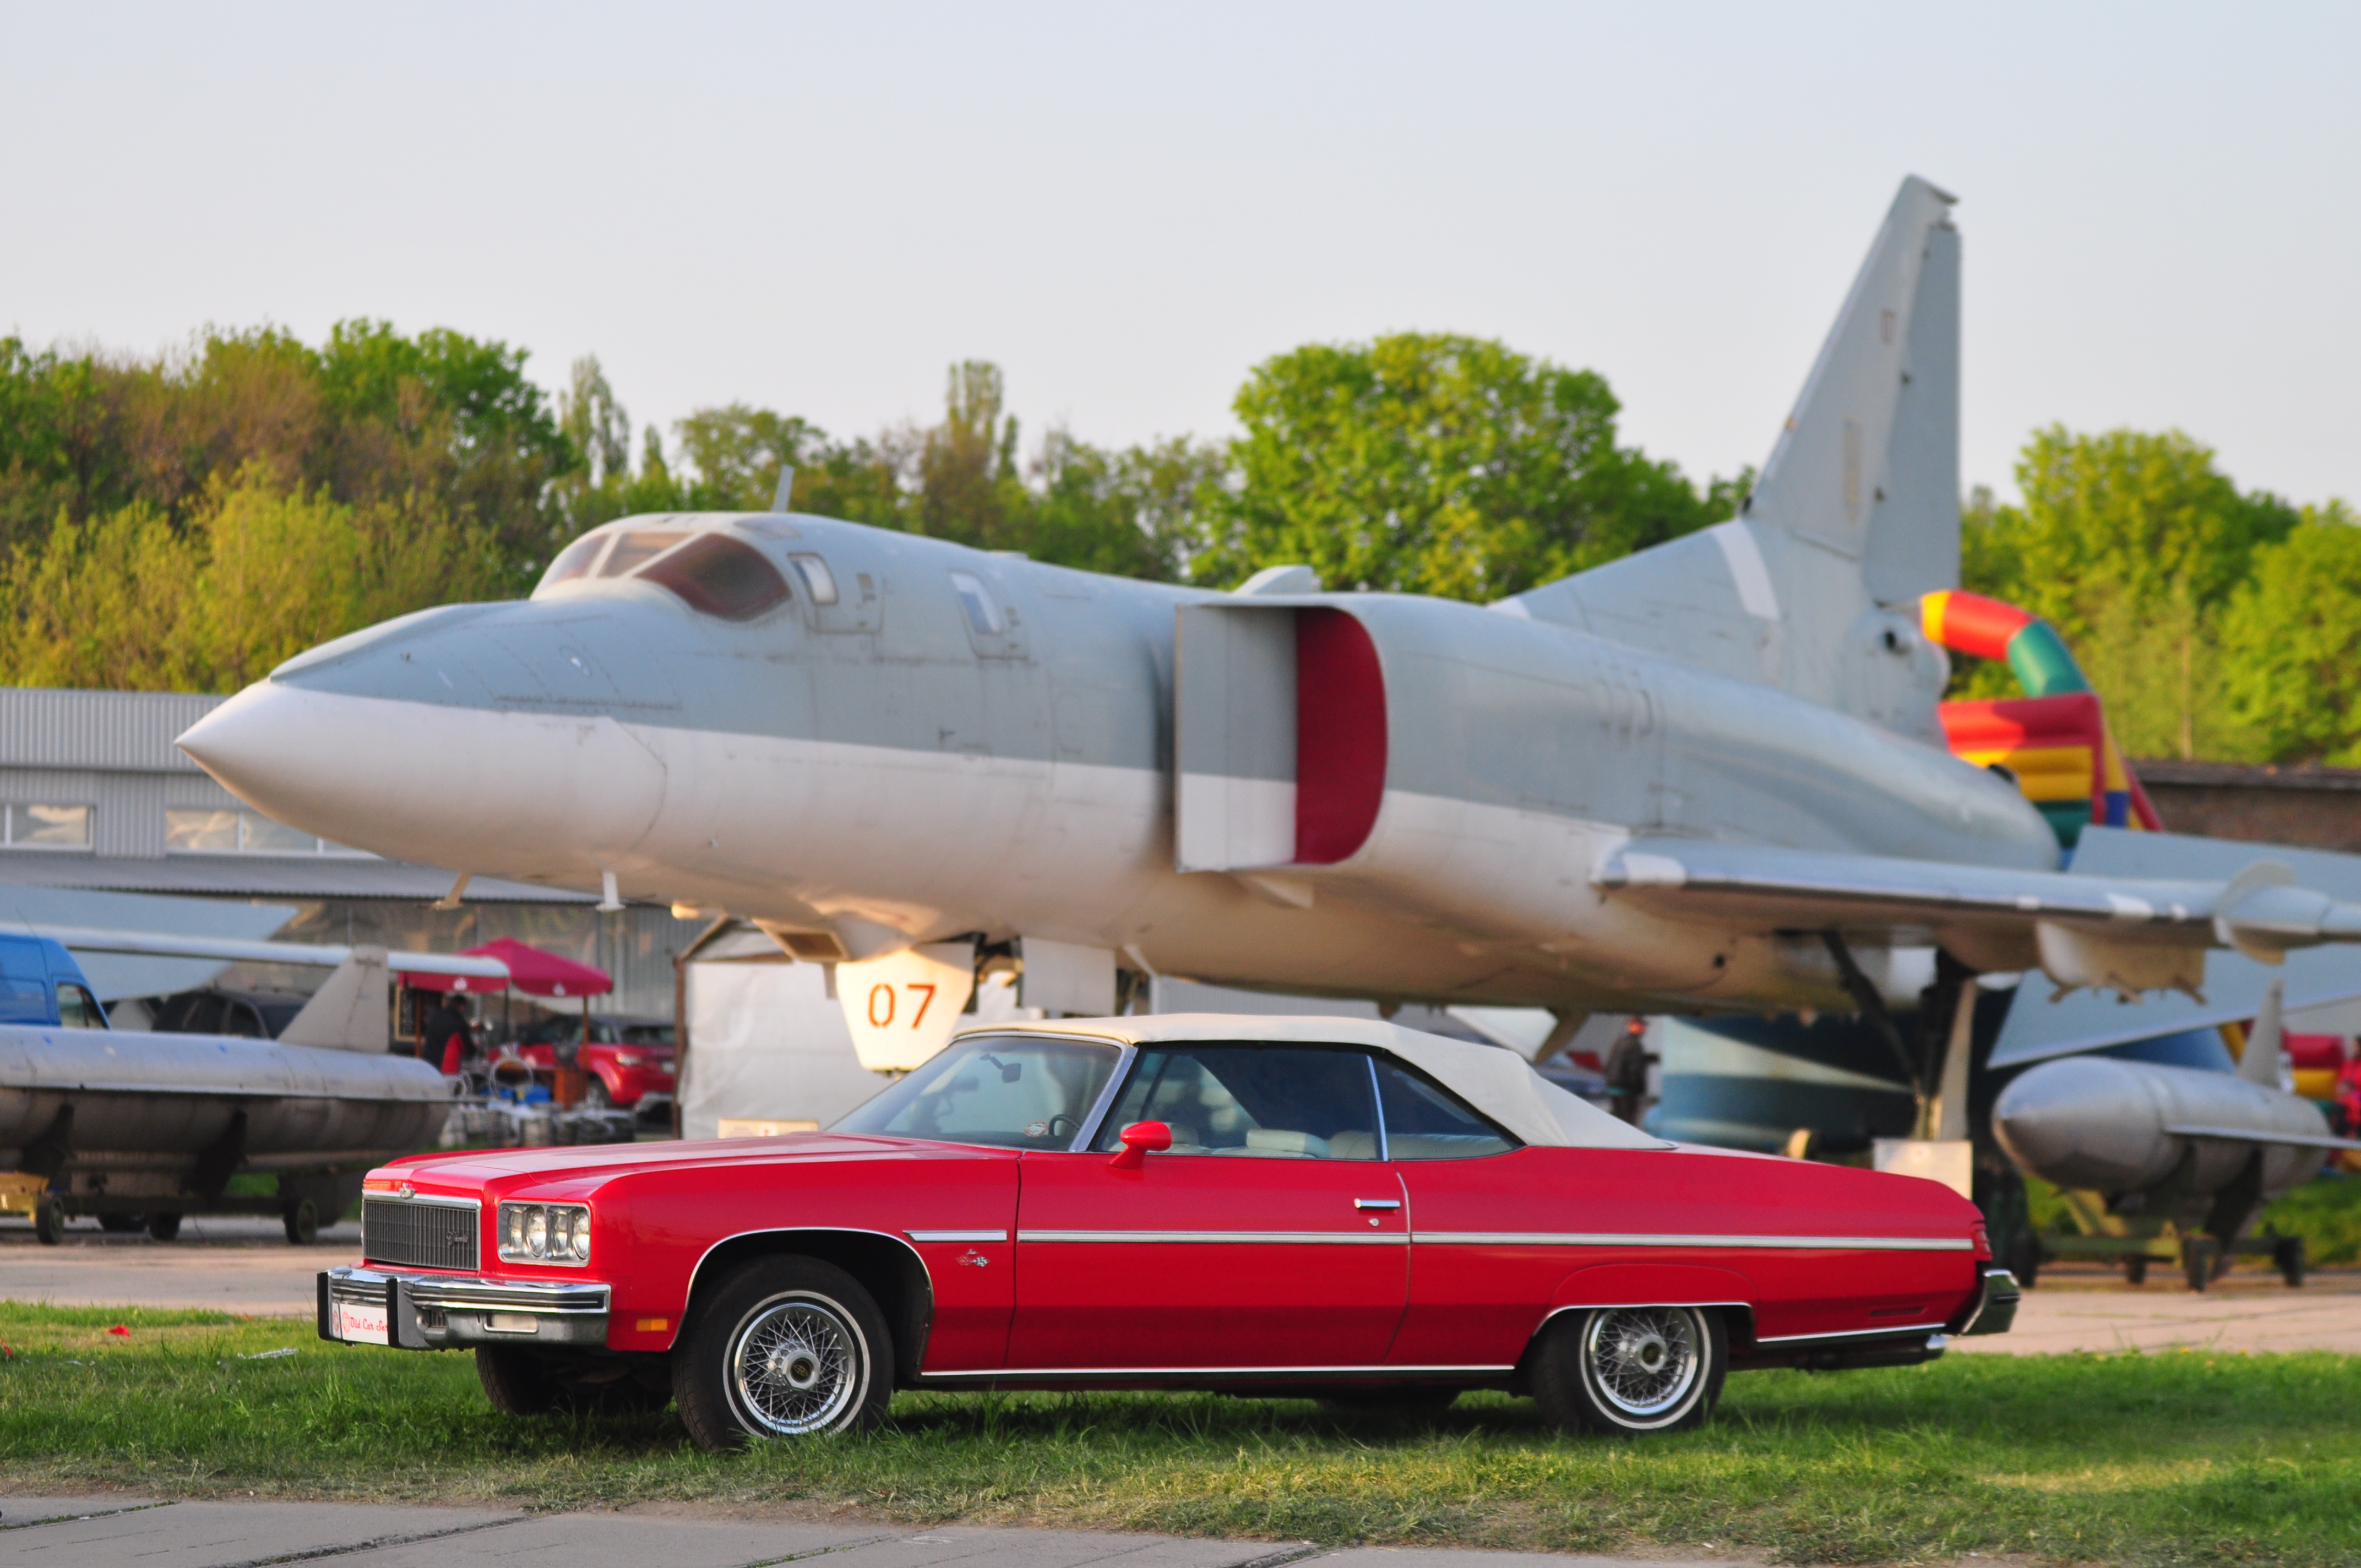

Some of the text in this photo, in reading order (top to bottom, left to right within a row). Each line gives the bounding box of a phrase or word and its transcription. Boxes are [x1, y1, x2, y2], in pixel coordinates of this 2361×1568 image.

[868, 983, 935, 1030] 07
[350, 1316, 361, 1329] Old
[363, 1318, 374, 1331] Car
